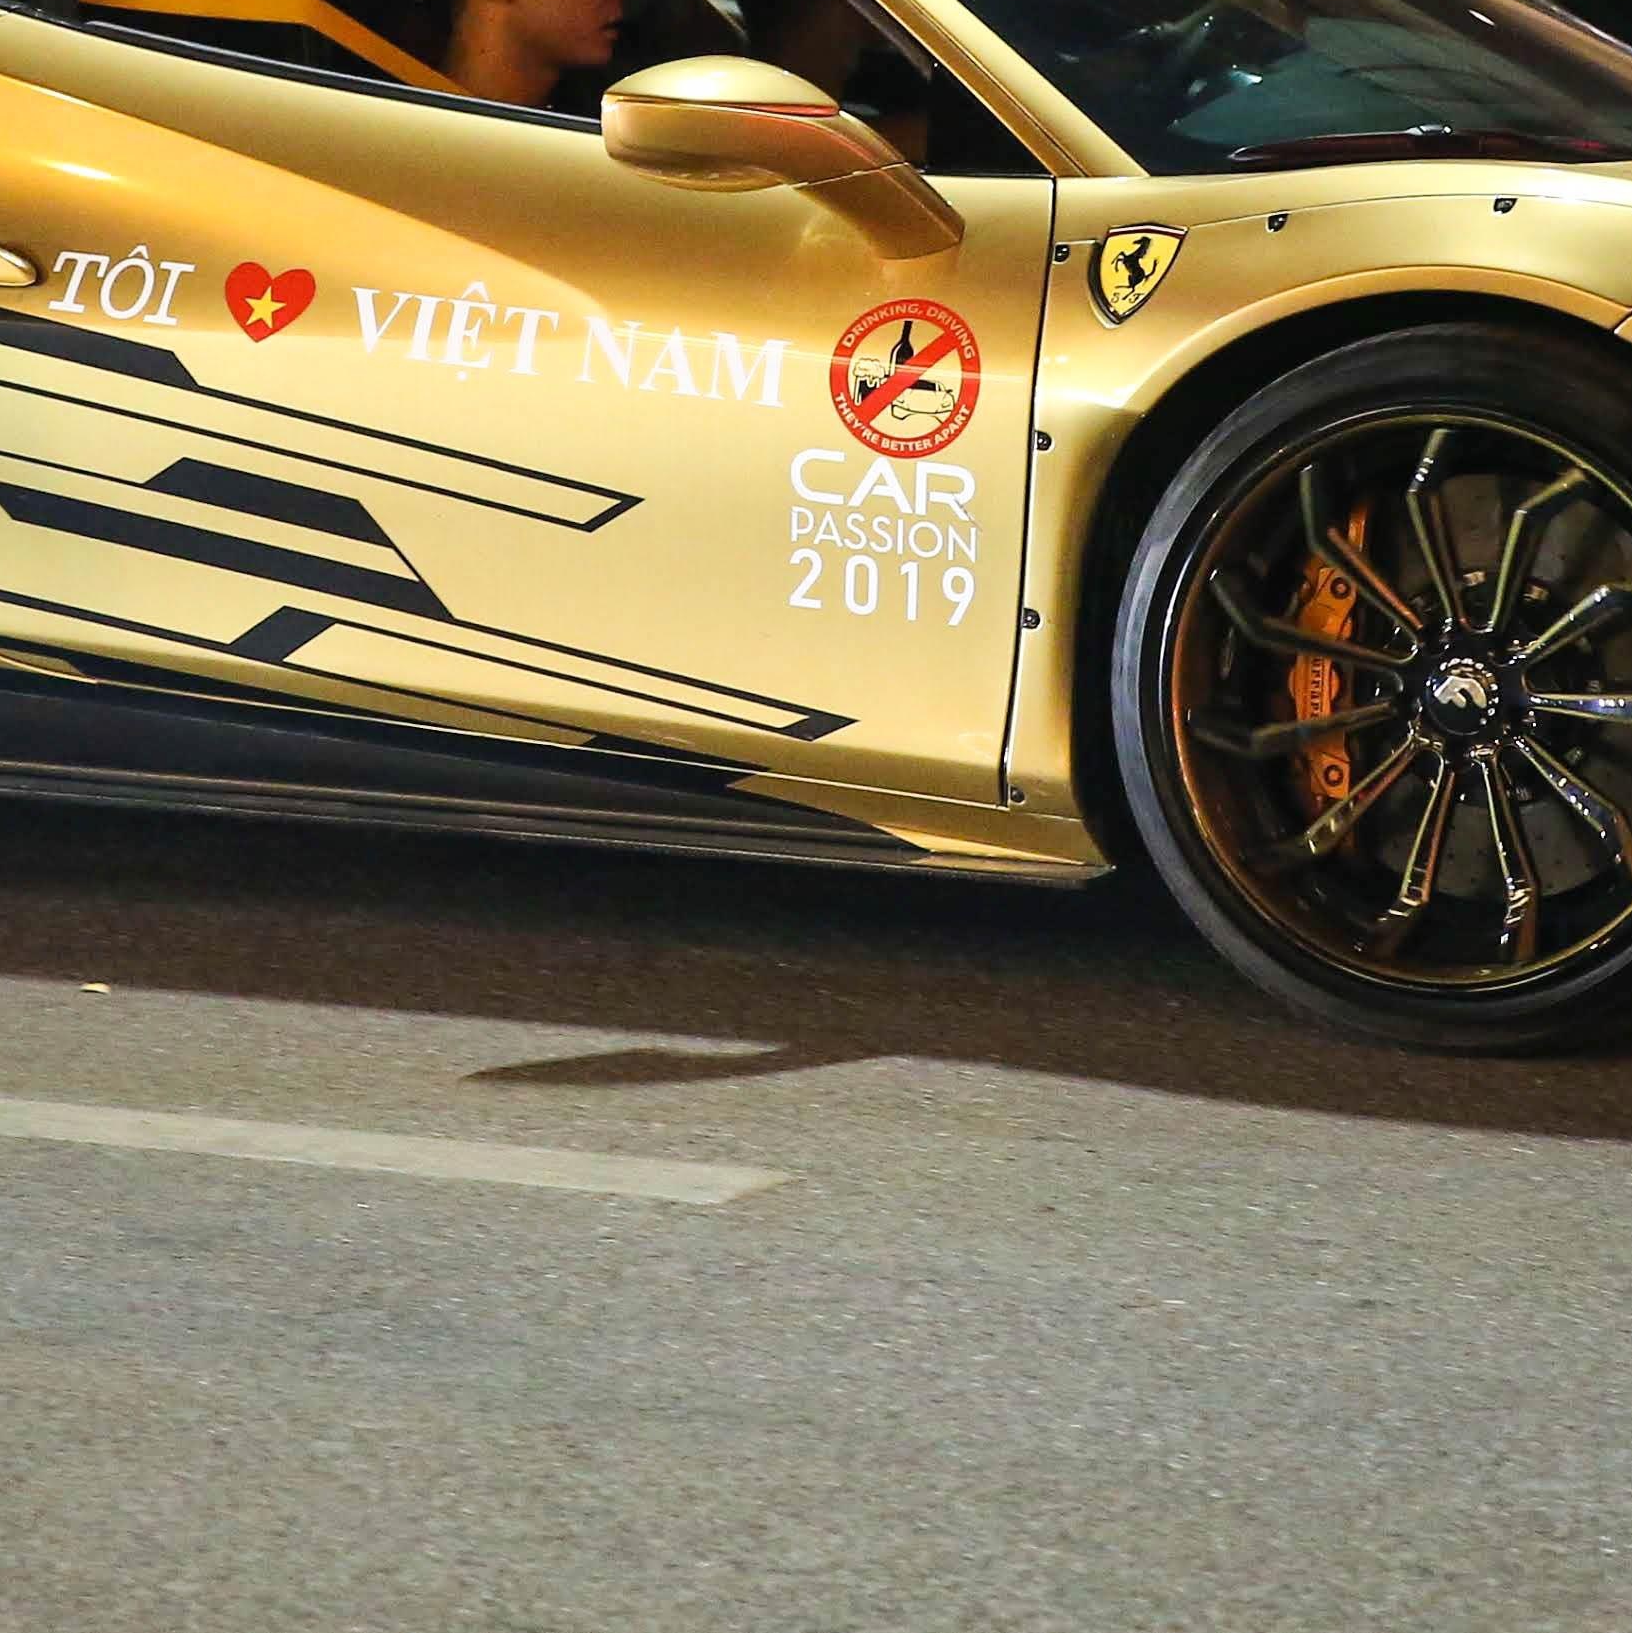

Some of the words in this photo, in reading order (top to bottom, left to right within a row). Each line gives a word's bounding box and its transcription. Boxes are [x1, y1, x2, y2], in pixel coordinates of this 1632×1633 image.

[48, 244, 196, 326] TÔI
[351, 279, 560, 382] VIỆT
[575, 314, 795, 408] NAM
[841, 303, 924, 348] DRINKING,
[926, 305, 976, 361] DRIVING
[835, 392, 880, 445] THEY'RE
[880, 438, 934, 452] BETTER
[933, 404, 971, 445] APART
[790, 448, 976, 522] CAR
[791, 505, 977, 564] PASSION
[788, 548, 976, 627] 2019
